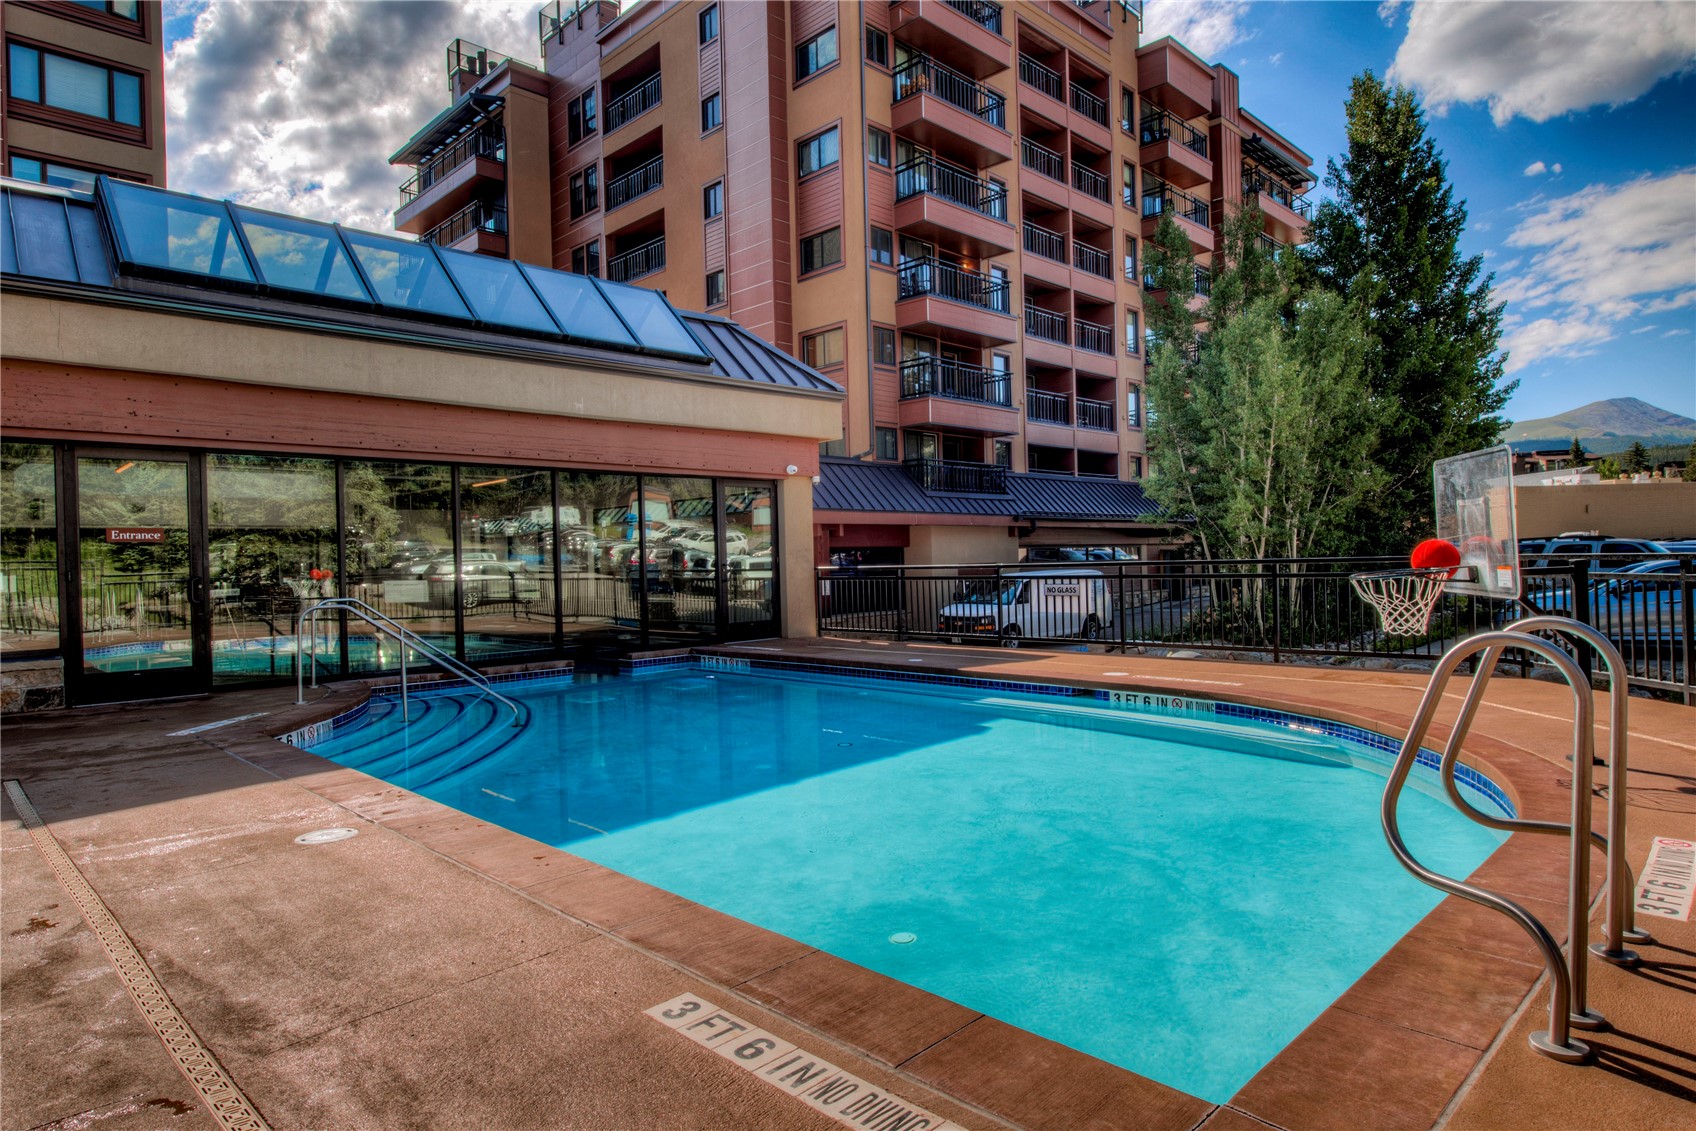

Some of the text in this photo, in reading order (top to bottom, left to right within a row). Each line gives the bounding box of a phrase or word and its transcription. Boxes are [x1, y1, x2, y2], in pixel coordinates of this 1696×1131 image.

[111, 530, 161, 540] Entrance
[1046, 586, 1077, 594] NO GLASS
[1113, 692, 1215, 714] 3 FT 6 IN NO DIVING
[286, 729, 306, 746] 6 IN
[661, 1001, 702, 1020] 3
[685, 1012, 748, 1042] FT
[733, 1037, 777, 1060] 6
[765, 1055, 828, 1089] IN
[807, 1076, 860, 1106] NO
